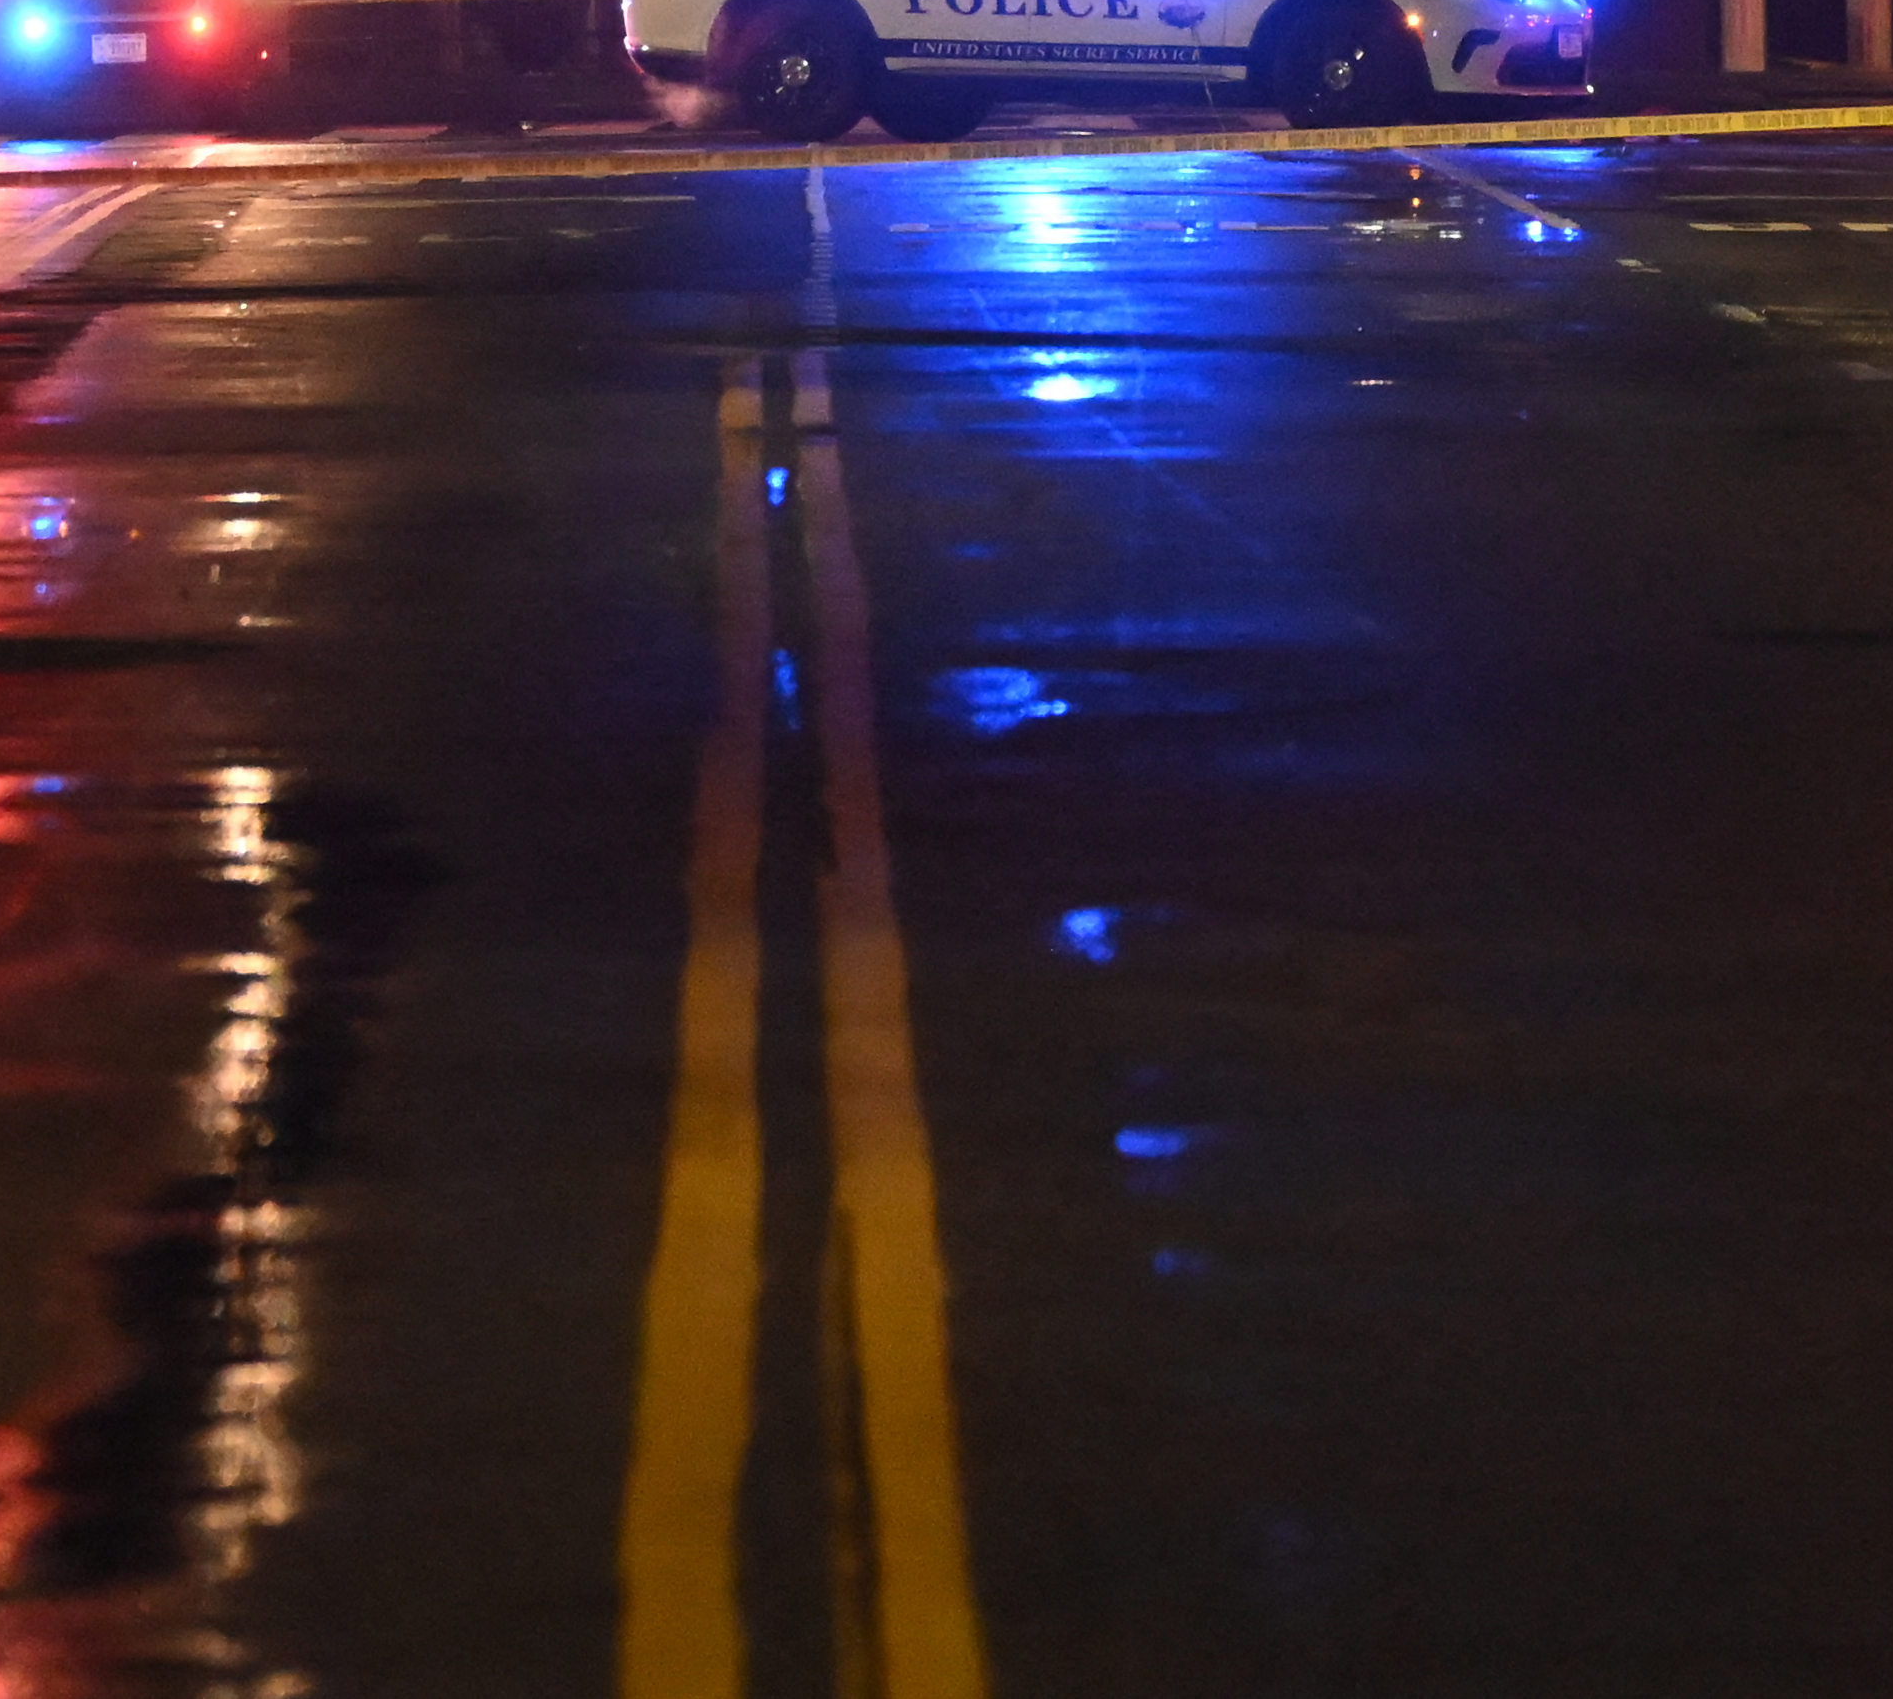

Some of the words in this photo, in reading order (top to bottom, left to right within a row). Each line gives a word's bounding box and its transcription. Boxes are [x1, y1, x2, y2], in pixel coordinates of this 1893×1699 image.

[912, 41, 980, 56] UNITED
[983, 44, 1046, 58] STATES
[1052, 45, 1120, 60] SECRET
